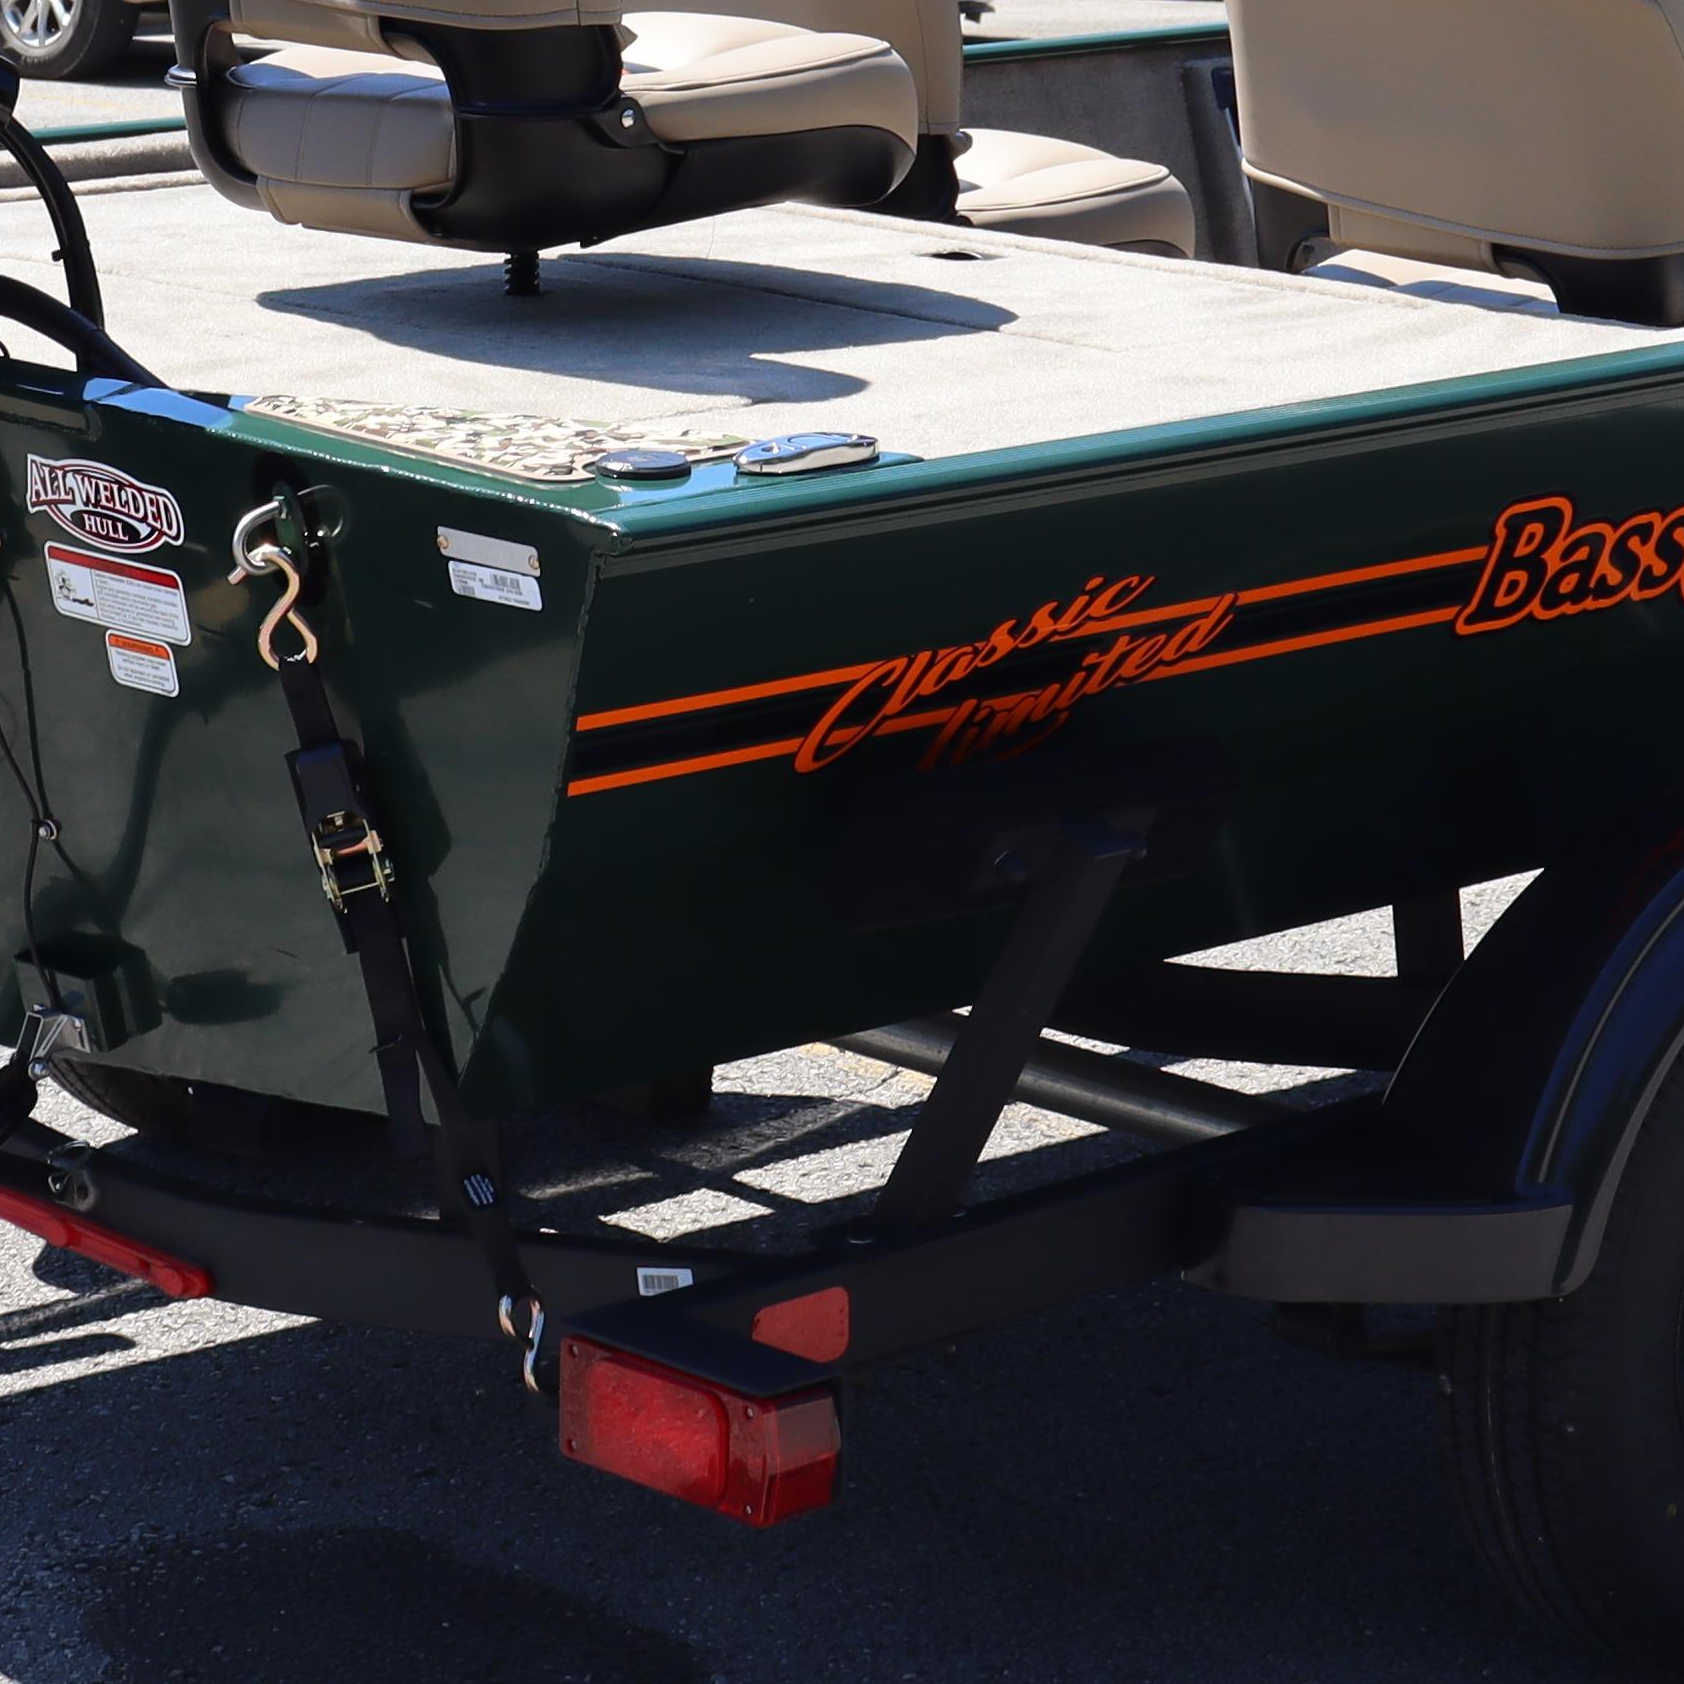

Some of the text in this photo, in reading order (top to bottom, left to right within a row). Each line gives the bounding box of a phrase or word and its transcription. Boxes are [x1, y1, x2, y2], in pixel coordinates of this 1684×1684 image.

[31, 463, 178, 537] ALL WELDED
[82, 513, 128, 540] HULL
[792, 574, 1157, 774] Classic
